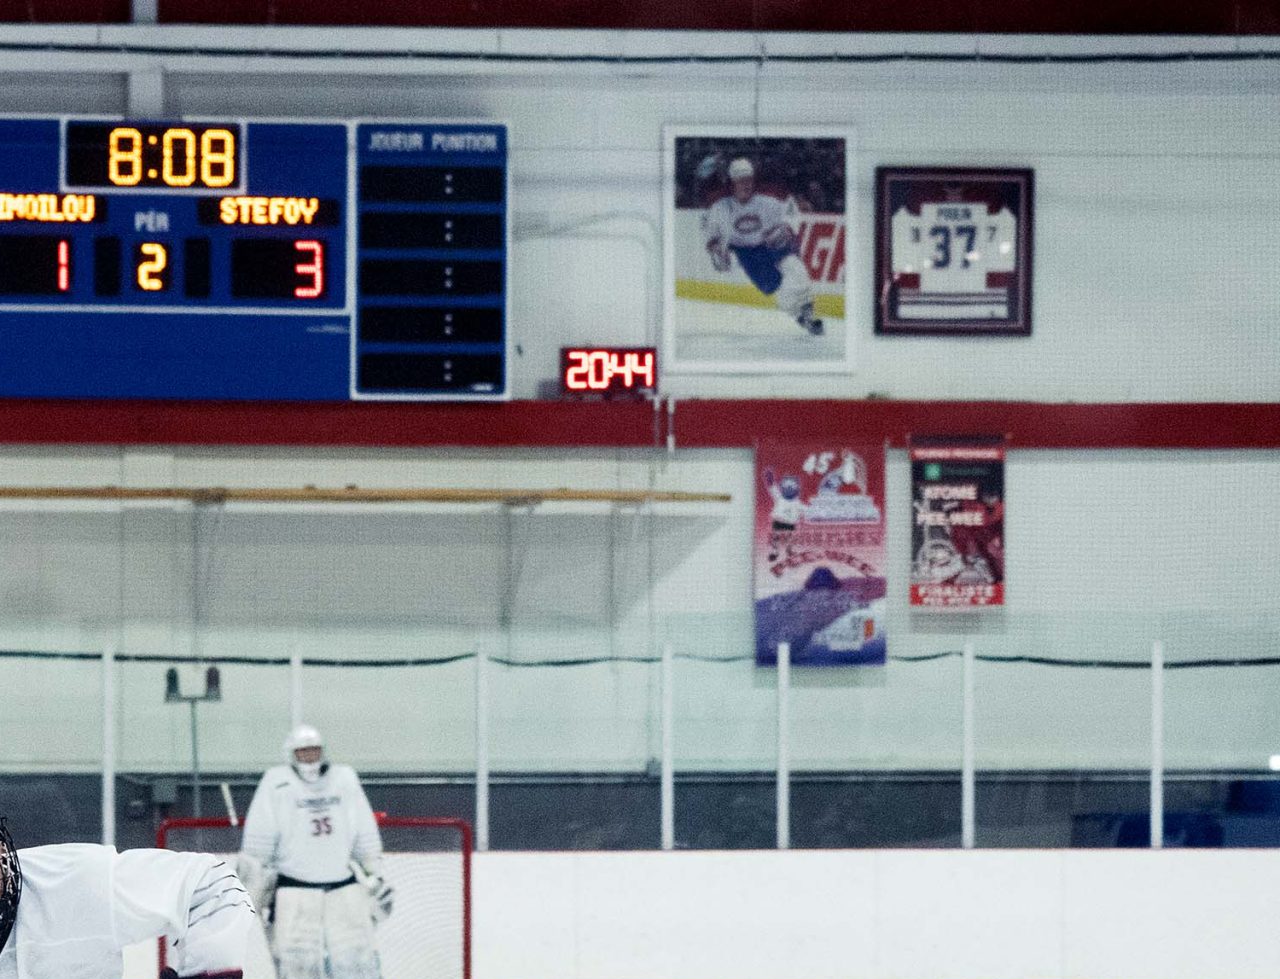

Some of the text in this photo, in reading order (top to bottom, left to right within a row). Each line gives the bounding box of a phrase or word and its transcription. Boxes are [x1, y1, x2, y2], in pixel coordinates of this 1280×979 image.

[108, 127, 235, 187] 8:08
[220, 196, 319, 225] STEFOY
[57, 240, 69, 291] 1
[137, 242, 167, 291] 2
[294, 240, 323, 298] 3
[929, 225, 977, 269] 37
[311, 816, 332, 837] 35
